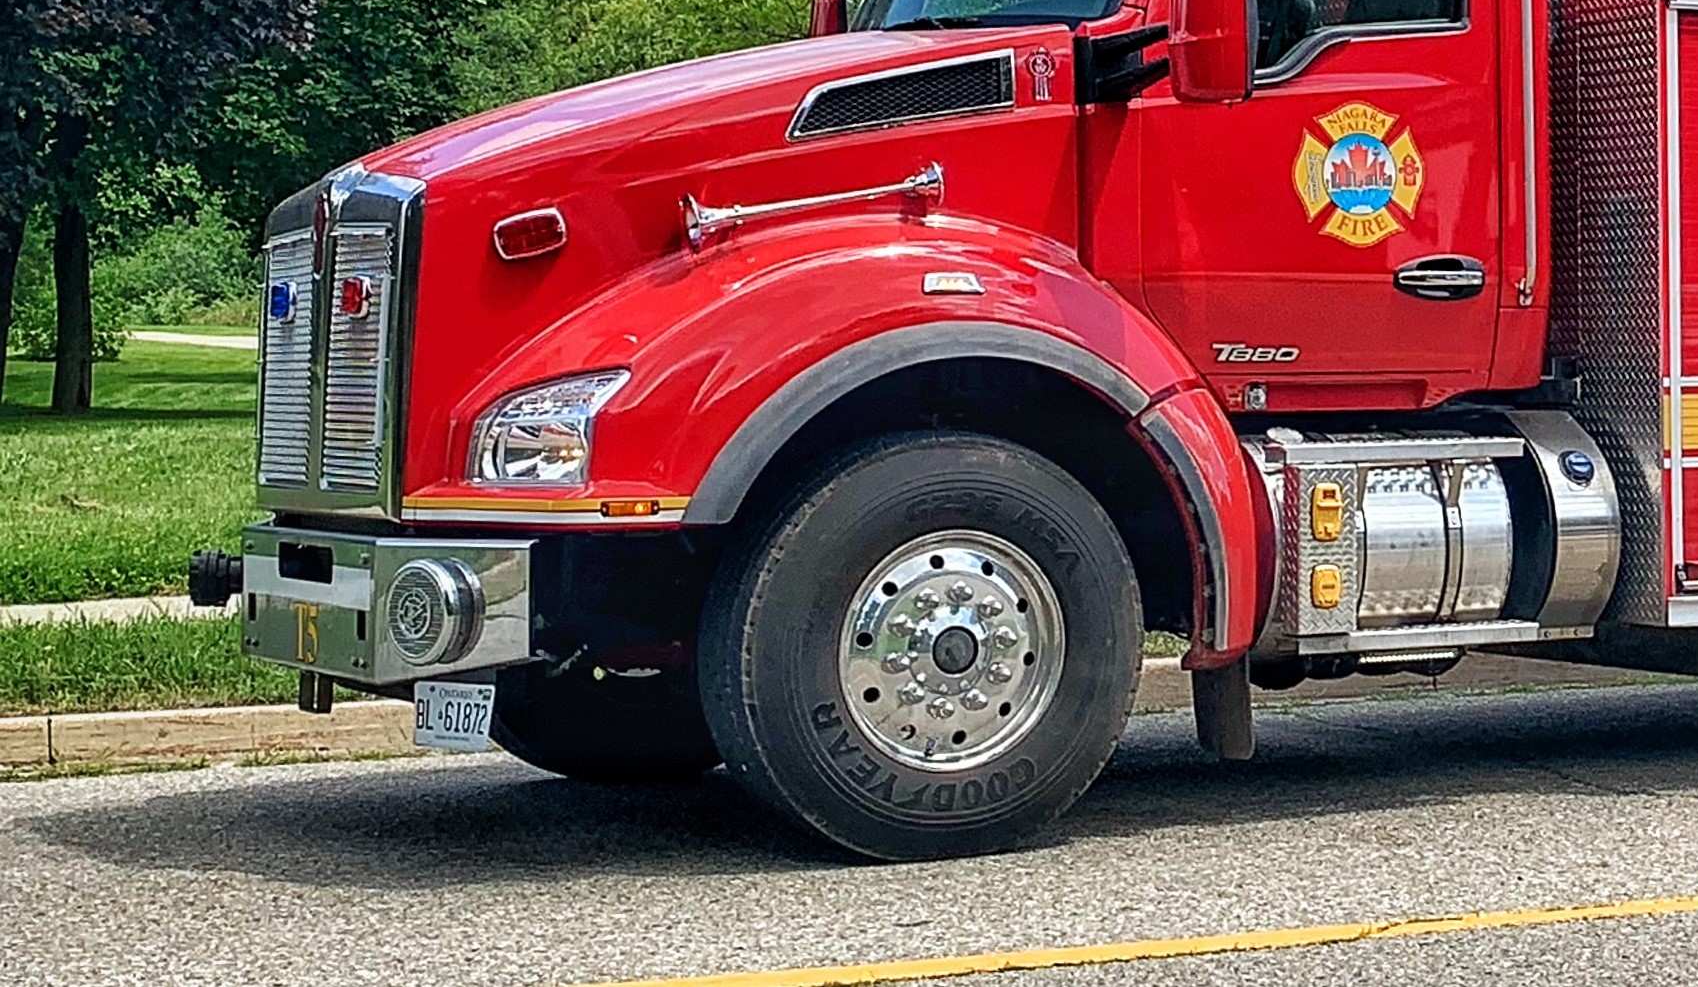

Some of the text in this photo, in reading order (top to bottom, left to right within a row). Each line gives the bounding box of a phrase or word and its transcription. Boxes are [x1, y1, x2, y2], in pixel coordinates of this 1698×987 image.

[1326, 106, 1387, 130] NIAGARA
[1339, 120, 1378, 135] FALLS
[1335, 214, 1389, 237] FIRE
[1211, 342, 1301, 363] T880
[293, 601, 319, 665] T5
[416, 698, 488, 736] BL 61872
[810, 700, 1038, 813] GOODYEAR
